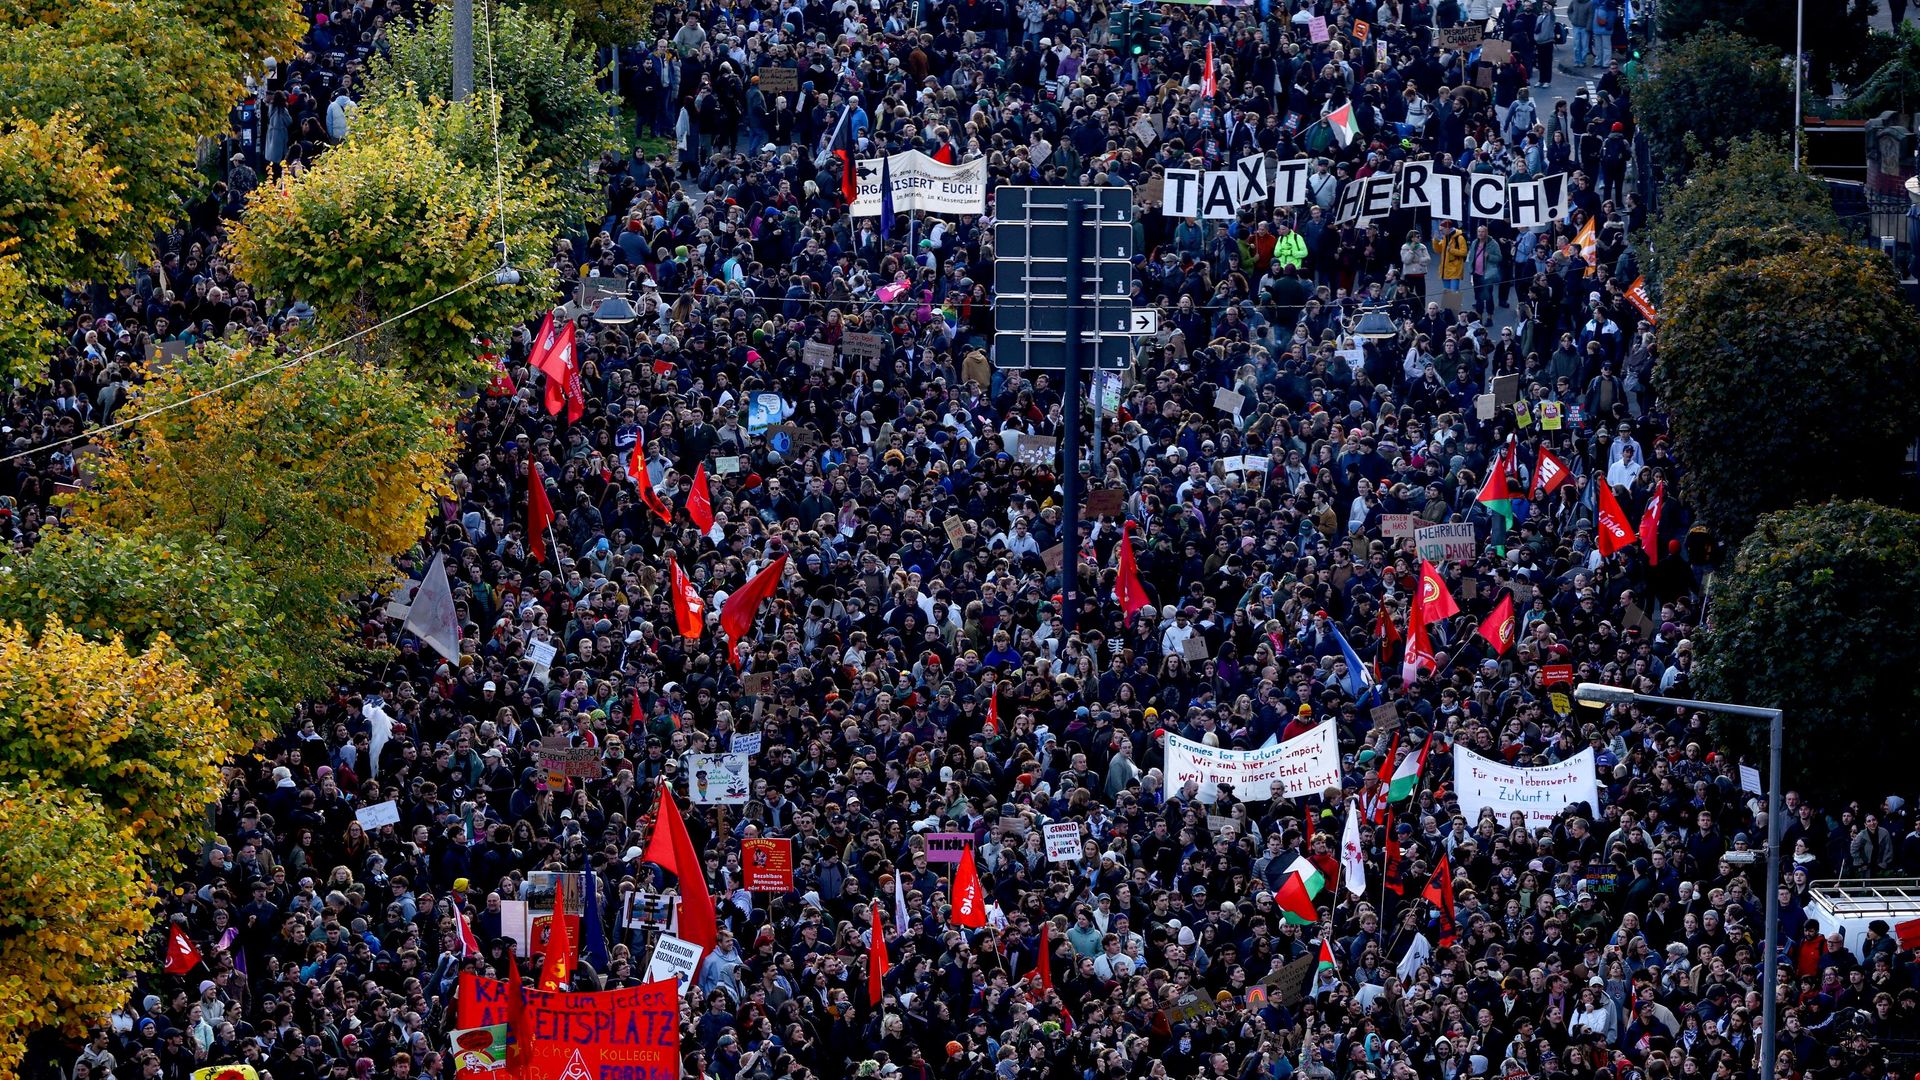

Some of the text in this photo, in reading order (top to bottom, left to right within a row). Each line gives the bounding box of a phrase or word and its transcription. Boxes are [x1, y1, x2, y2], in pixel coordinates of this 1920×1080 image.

[1444, 27, 1481, 37] DISRUPTIVE
[1447, 34, 1477, 44] CHANGE
[942, 182, 978, 195] EUCH!
[1402, 165, 1565, 224] RICH!
[1392, 521, 1408, 530] HASS
[1420, 542, 1475, 560] NEIN DANKE
[1168, 735, 1213, 757] Grannies
[1219, 751, 1234, 761] for
[1243, 746, 1282, 761] Future
[1192, 755, 1212, 768] Wir
[1216, 762, 1237, 770] sind
[1242, 761, 1264, 771] hier
[1178, 762, 1308, 783] weil man unsere Enkel
[1472, 767, 1487, 779] Für
[1493, 776, 1515, 785] eine
[1284, 769, 1340, 794] cht hört!
[1050, 823, 1077, 833] GENOZID
[743, 839, 777, 848] WIDERSTAND
[928, 836, 973, 851] TH KÖLN
[1057, 846, 1075, 855] NICHT
[1587, 884, 1617, 893] PLANET
[659, 939, 694, 958] GENERATION
[655, 951, 693, 971] SOZIALISMUS
[565, 993, 596, 1010] um
[600, 1048, 660, 1062] KOLLEGEN
